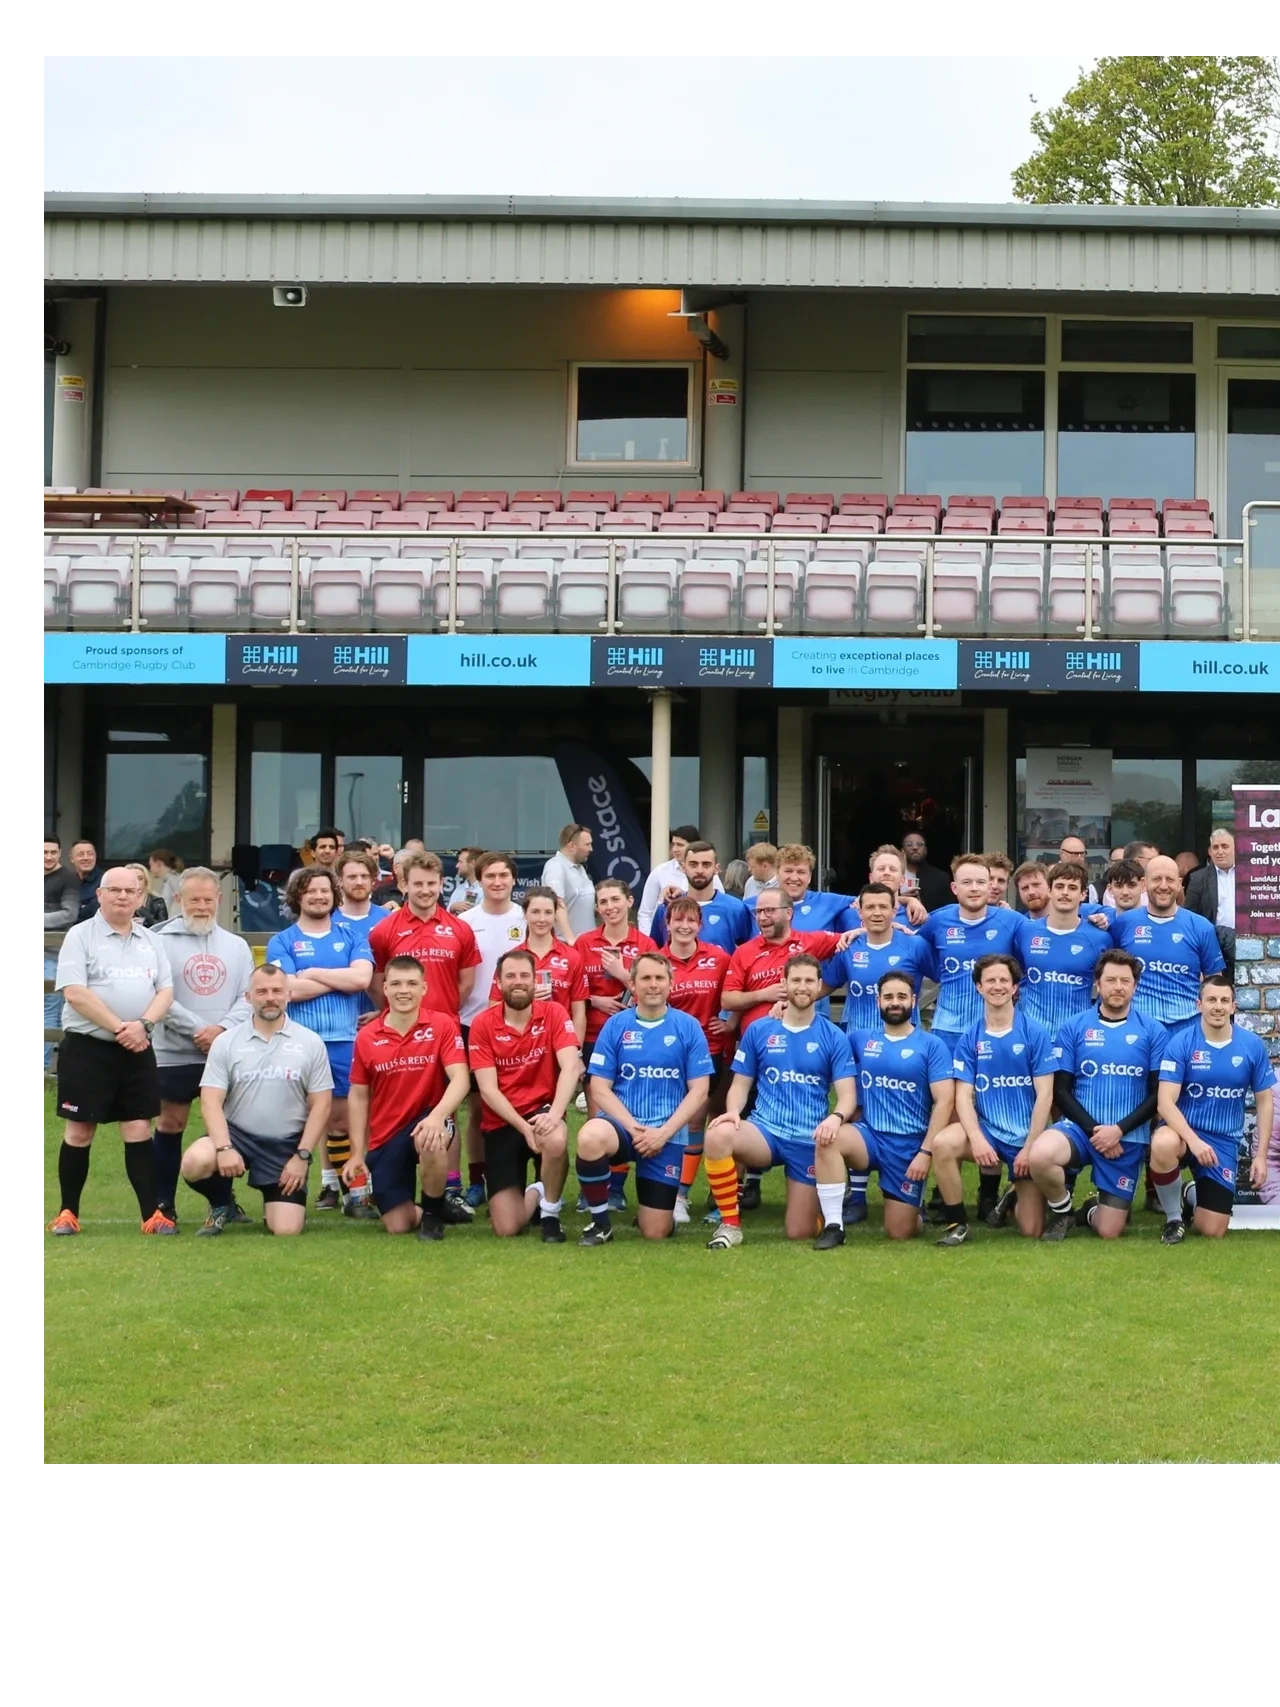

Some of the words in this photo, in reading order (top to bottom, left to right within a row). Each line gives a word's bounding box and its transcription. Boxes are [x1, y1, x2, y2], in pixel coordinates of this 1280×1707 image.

[85, 646, 118, 655] Proud
[120, 648, 169, 657] sponsors
[172, 646, 184, 655] of
[263, 646, 298, 664] Hill
[354, 647, 389, 664] Hill
[628, 648, 663, 666] Hill
[720, 649, 755, 667] Hill
[791, 651, 837, 662] Creating
[839, 651, 902, 662] exceptional
[904, 651, 940, 663] places
[72, 661, 132, 672] Cambridge
[134, 661, 168, 672] Rugby
[171, 661, 196, 670] Club
[460, 652, 538, 668] hill.co.uk
[996, 652, 1030, 669] Hill
[1087, 653, 1121, 670] Hill
[243, 665, 268, 674] Created
[269, 666, 278, 674] for
[278, 665, 298, 677] Living
[608, 667, 633, 675] Created
[634, 667, 643, 675] for
[643, 666, 663, 678] Living
[811, 666, 823, 675] to
[826, 665, 845, 675] live
[848, 665, 858, 675] in
[860, 665, 920, 677] Cambridge
[1192, 660, 1269, 675] hill.co.uk
[975, 670, 1000, 679] Created
[1001, 671, 1010, 679] for
[1011, 670, 1030, 682] Living
[588, 774, 625, 852] stace
[1250, 856, 1269, 865] end
[517, 878, 540, 887] Wish
[1250, 885, 1277, 893] working
[512, 892, 526, 901] go
[421, 947, 429, 956] &
[429, 947, 455, 959] REEVE
[1149, 960, 1189, 975] stace
[1044, 970, 1083, 985] stace
[670, 982, 685, 993] LLS
[686, 980, 694, 989] &
[694, 980, 718, 989] REEVE
[374, 1058, 398, 1072] MILLS
[399, 1056, 407, 1066] &
[408, 1054, 435, 1065] REEVE
[1101, 1062, 1144, 1077] stace
[639, 1066, 680, 1079] stace
[782, 1070, 821, 1085] stace
[875, 1075, 917, 1093] stace
[992, 1075, 1033, 1088] stace
[1206, 1085, 1245, 1098] stace
